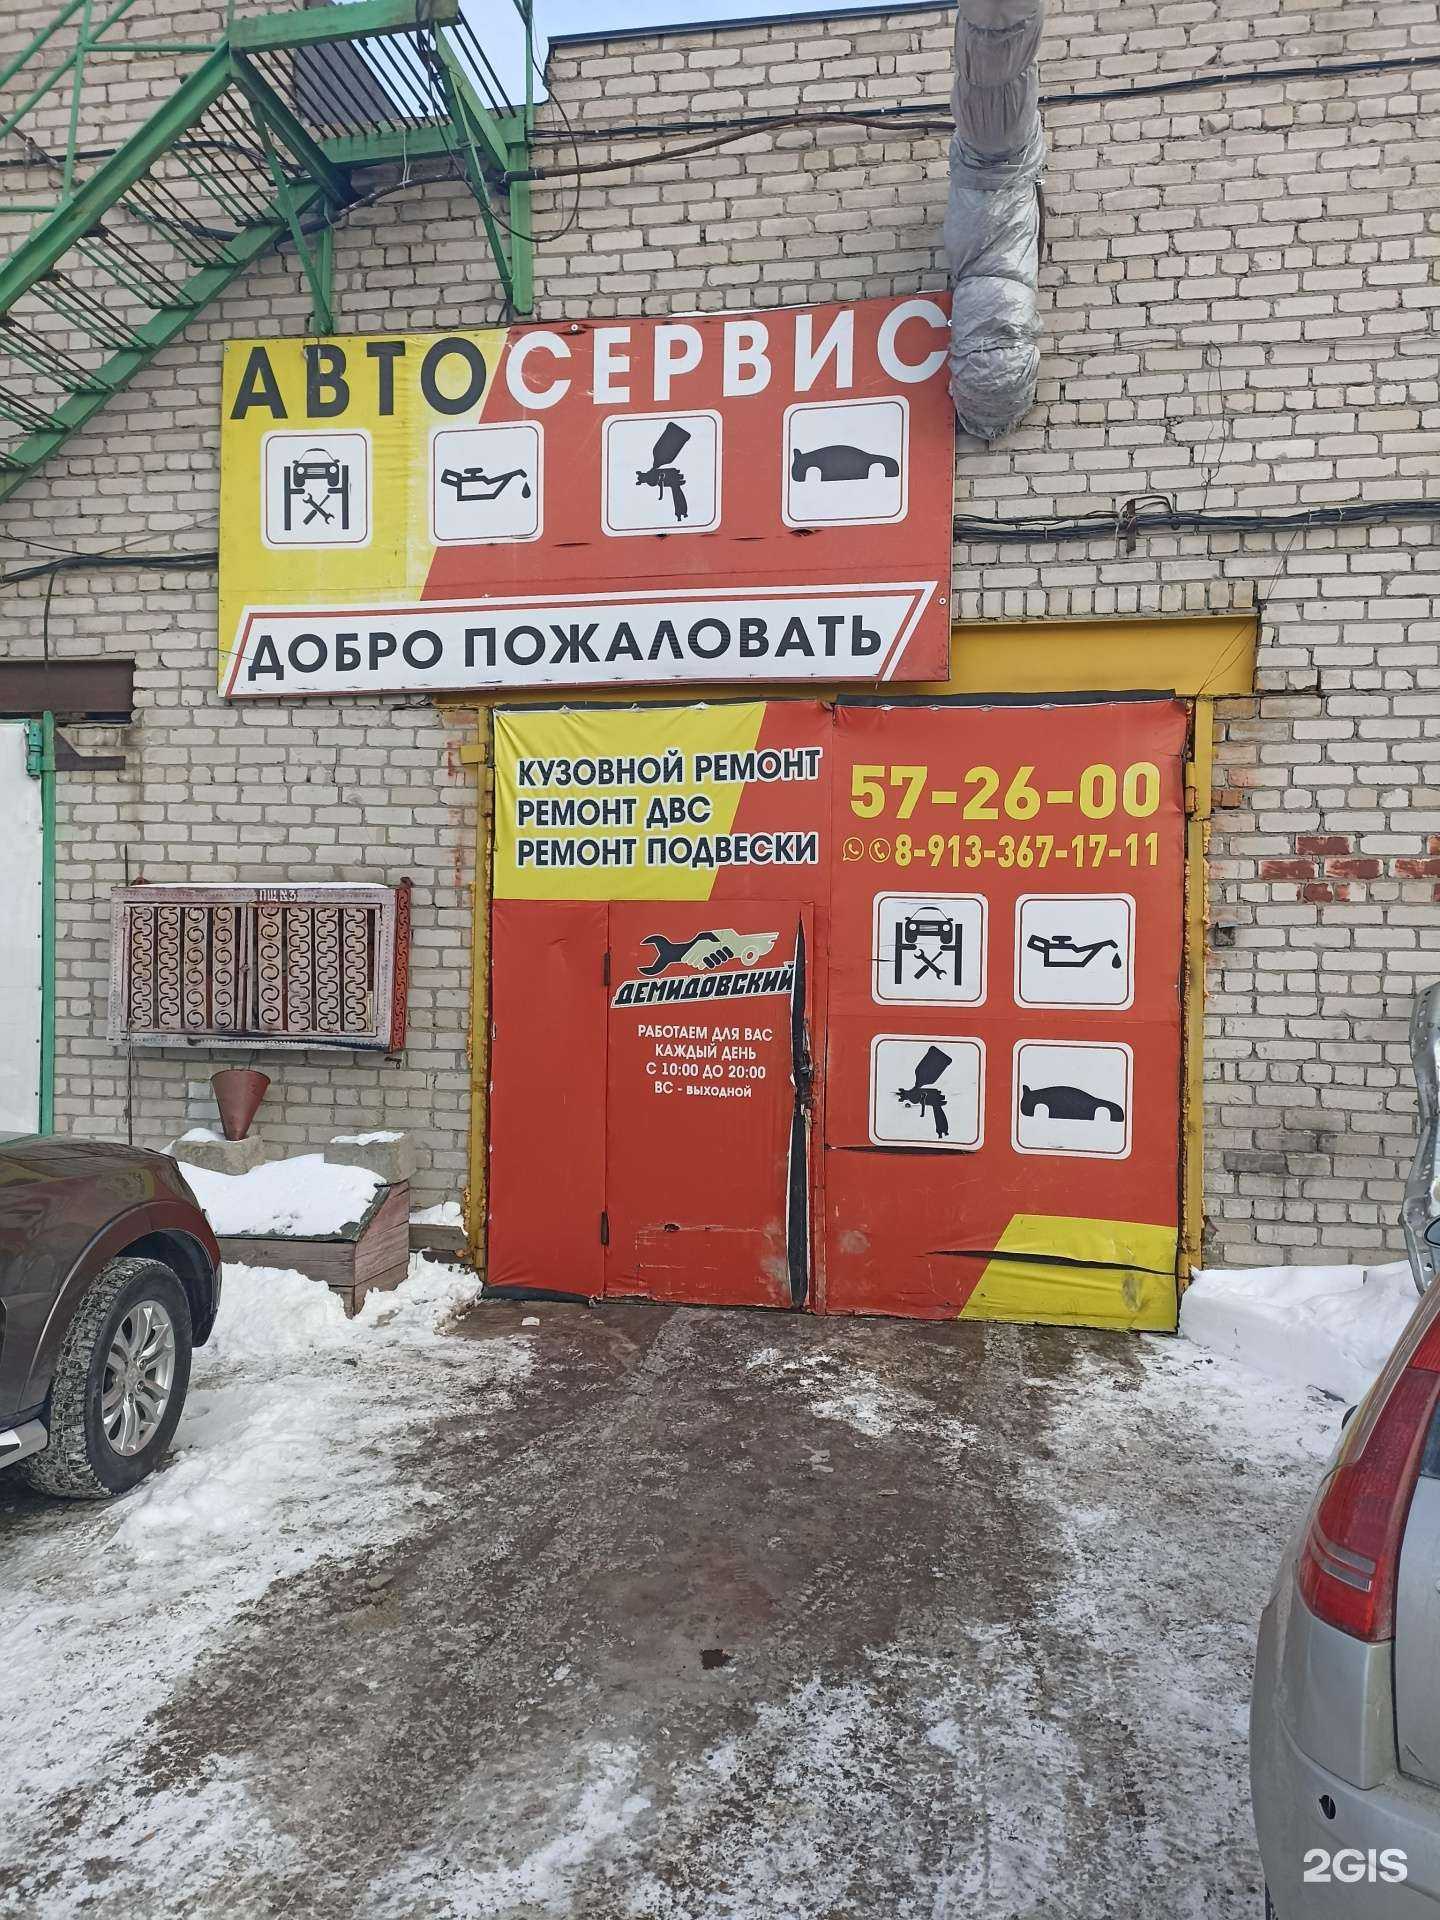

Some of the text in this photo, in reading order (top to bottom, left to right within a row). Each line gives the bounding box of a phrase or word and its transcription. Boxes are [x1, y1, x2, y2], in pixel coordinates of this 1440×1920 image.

[230, 299, 949, 420] АВТОСЕРВИС
[247, 615, 882, 682] ДОБРО ПОЖАЛОВАТЬ
[518, 750, 821, 787] КУЗОВНОЙ РЕМОНТ
[850, 761, 1160, 820] 57-26-00
[517, 796, 711, 829] РЕМОНТ ДВС
[517, 835, 817, 868] РЕМОНТ ПОДВЕСКИ
[895, 832, 1159, 868] 8-913-367-17-11
[613, 964, 795, 1006] ДЕМИДОВСКИЙ
[637, 1024, 773, 1042] РАБОТАЕМ ДЛЯ ВАС
[655, 1043, 756, 1061] КАЖДЫЙ ДЕНЬ
[646, 1062, 766, 1079] С 10:00 ДО 20:00
[654, 1081, 674, 1094] ВС
